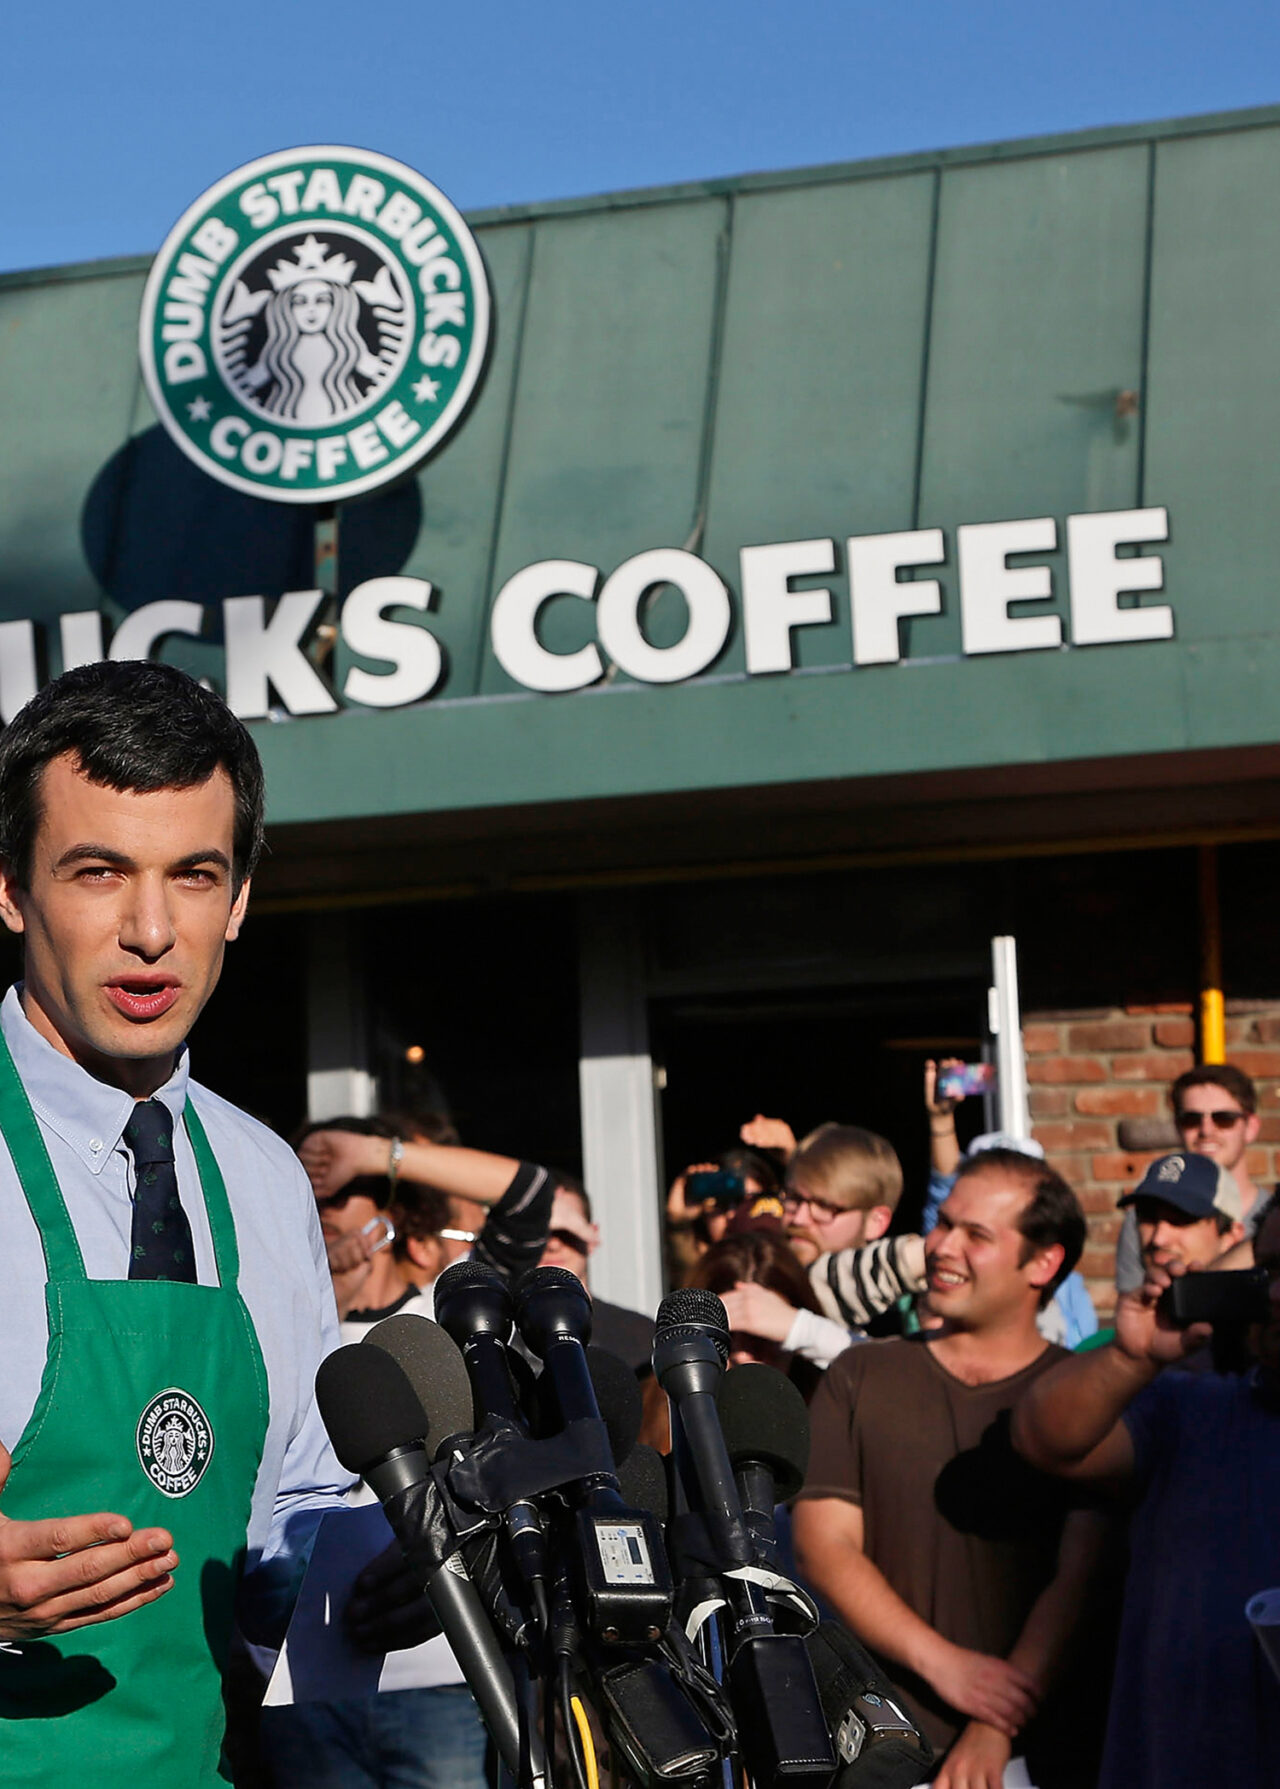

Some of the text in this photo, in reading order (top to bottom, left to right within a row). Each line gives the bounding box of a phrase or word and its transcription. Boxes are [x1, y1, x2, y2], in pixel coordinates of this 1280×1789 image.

[162, 168, 466, 385] DUMB STARBUCKS
[209, 400, 421, 481] COFFEE
[490, 506, 1174, 694] COFFEE
[142, 1398, 208, 1448] DUMB STARBUCKS
[150, 1463, 197, 1491] COFFEE
